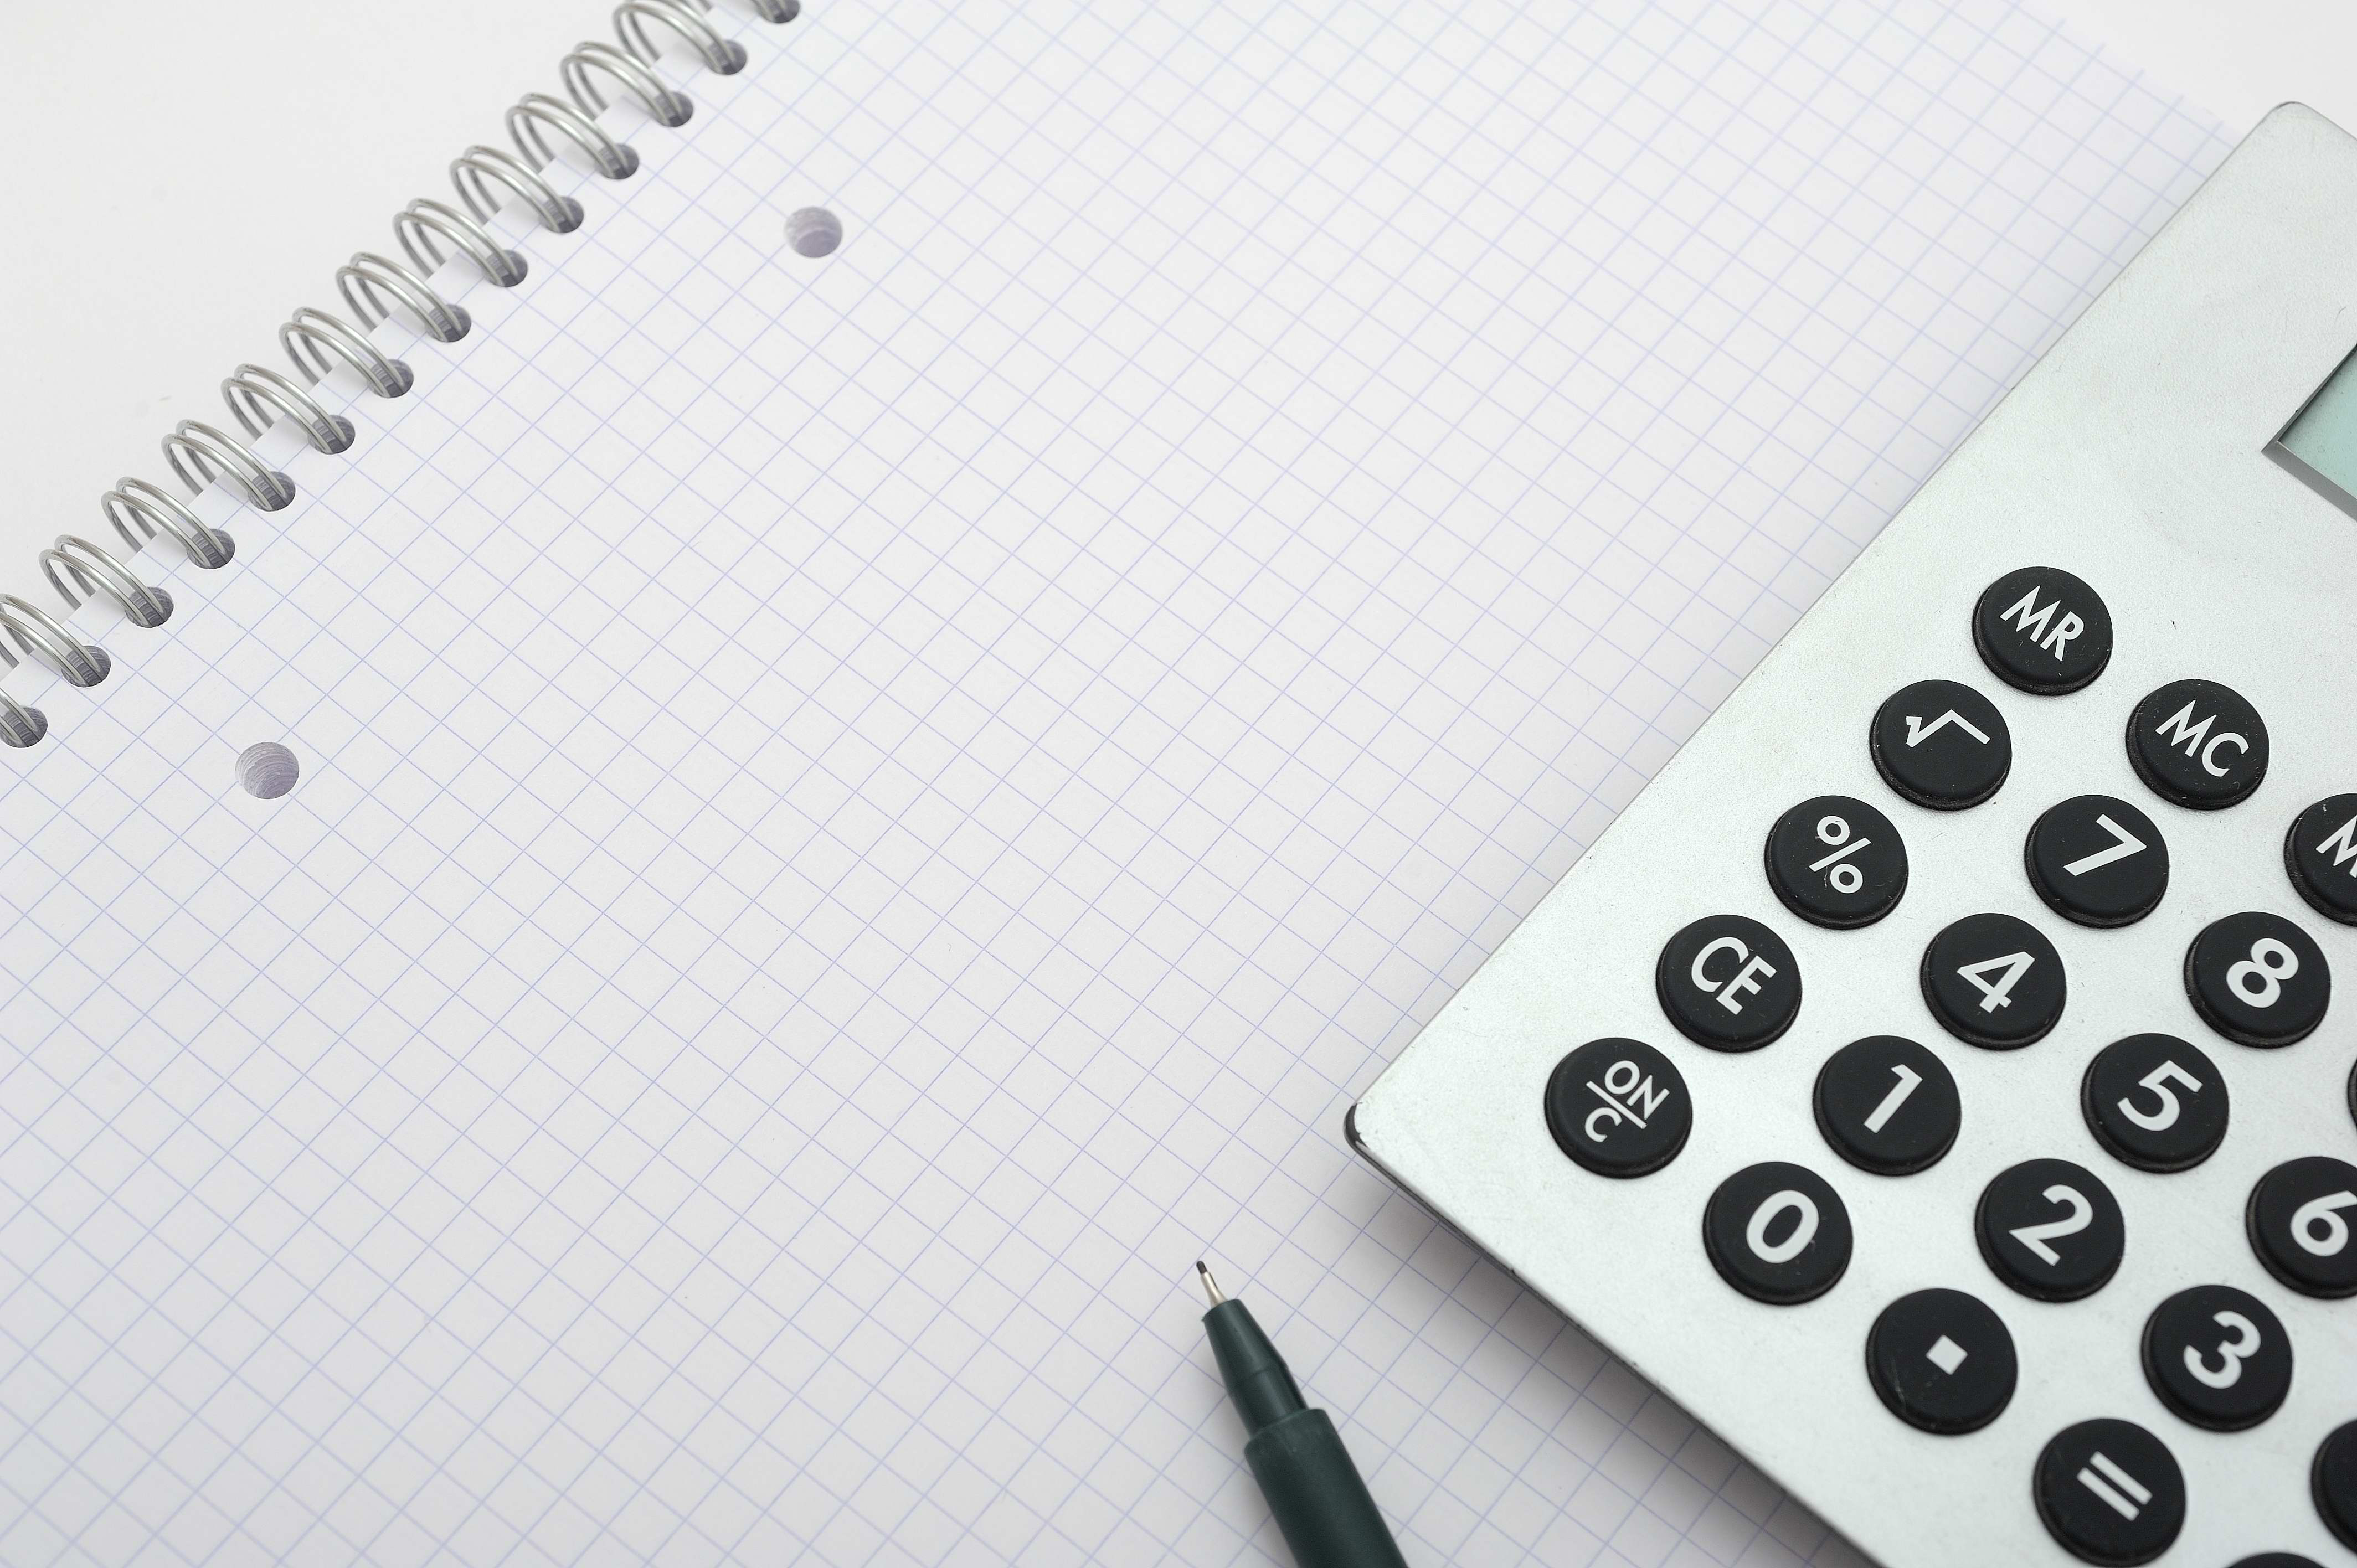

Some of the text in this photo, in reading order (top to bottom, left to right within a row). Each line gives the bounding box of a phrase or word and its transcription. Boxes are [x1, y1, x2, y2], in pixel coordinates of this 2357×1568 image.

[2000, 585, 2085, 662] MR
[2154, 699, 2249, 777] MC
[1809, 814, 1871, 894] %
[2062, 814, 2148, 876] 7
[1691, 936, 1777, 1015] CE
[1957, 951, 2036, 1013] 4
[2226, 937, 2299, 1008] 8
[1604, 1060, 1670, 1120] ON
[1864, 1064, 1923, 1133] 1
[2117, 1060, 2203, 1131] 5
[2009, 1184, 2093, 1266] 2
[2290, 1190, 2357, 1257] 6
[2183, 1310, 2261, 1389] 3
